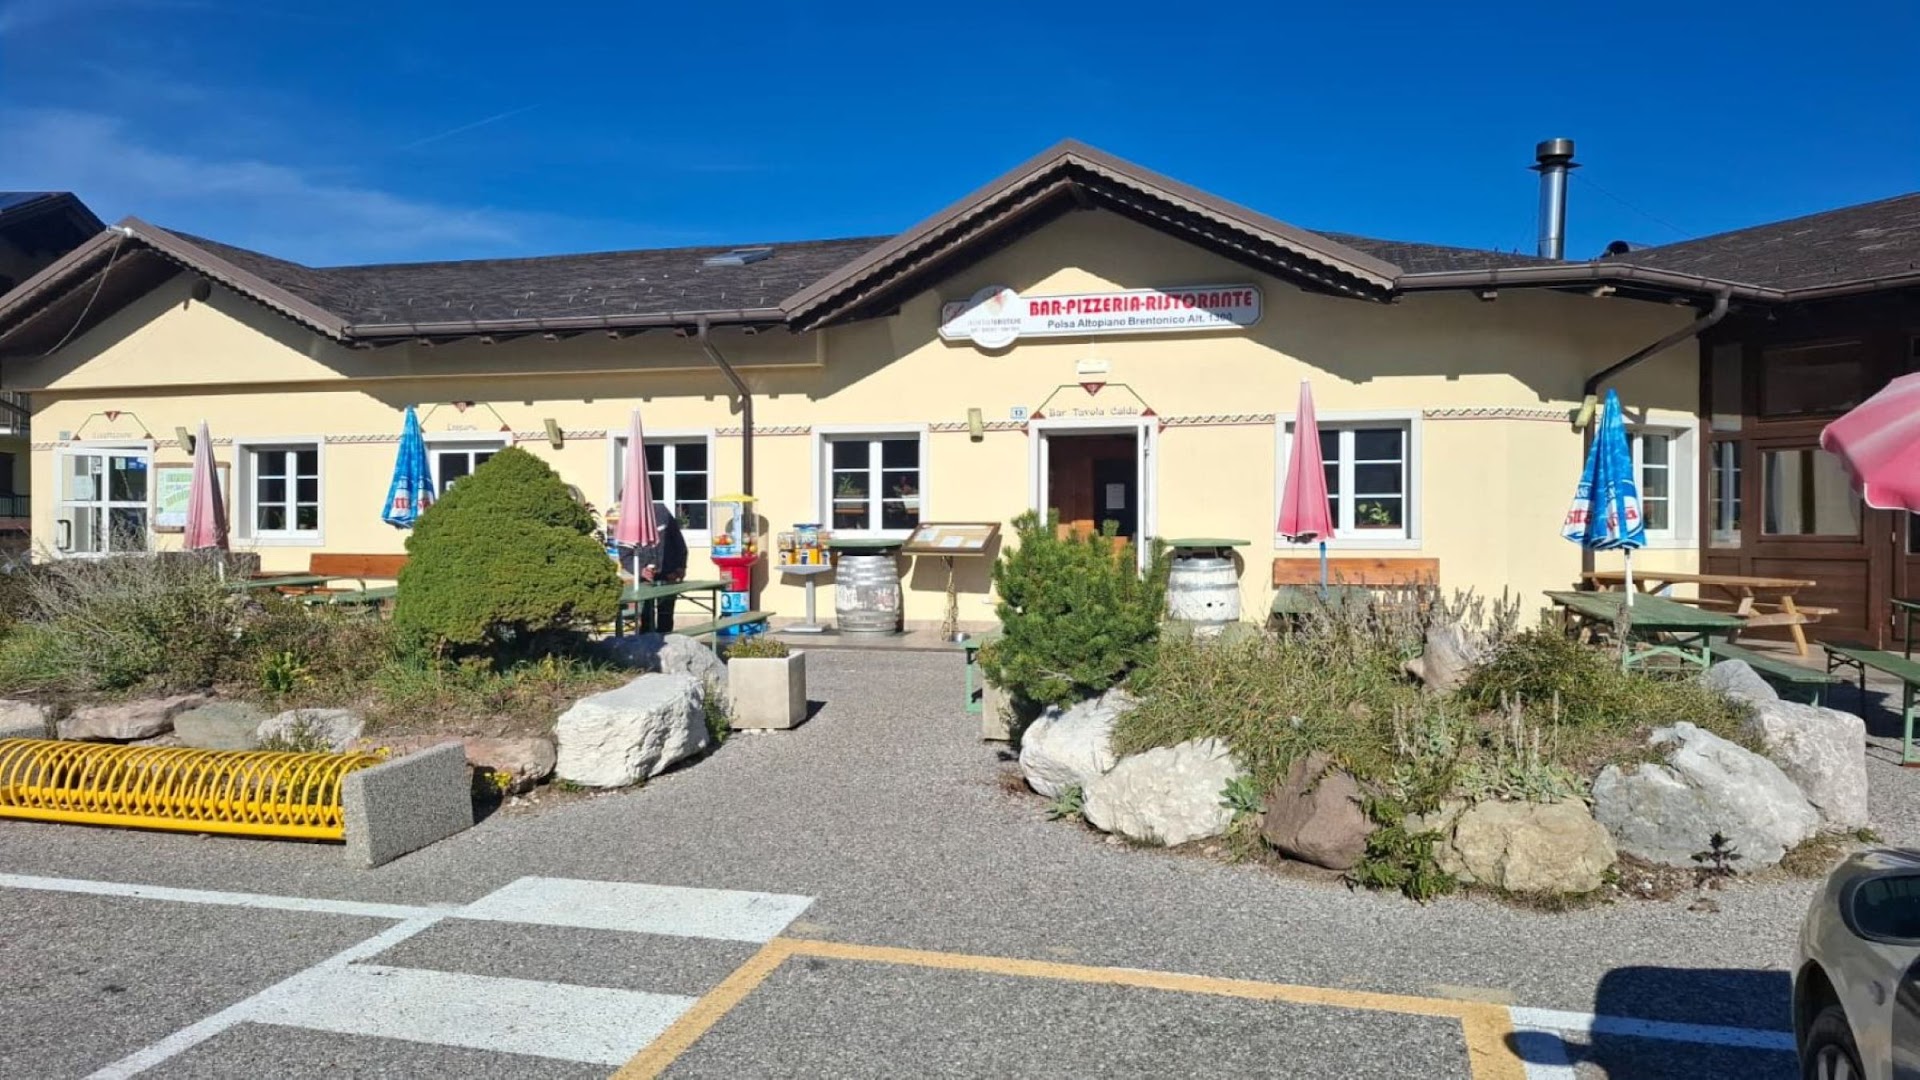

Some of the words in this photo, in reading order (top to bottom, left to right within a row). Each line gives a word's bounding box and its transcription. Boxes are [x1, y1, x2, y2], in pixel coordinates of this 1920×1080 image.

[1029, 291, 1252, 316] BAR-PIZZERIA-RISTORANTE
[1047, 319, 1075, 329] Polsa
[1077, 317, 1126, 328] Altopiano
[1127, 316, 1185, 326] Brentonico
[1188, 314, 1206, 323] Alt.
[1209, 312, 1233, 322] 1300
[1049, 408, 1067, 417] Bar
[1072, 407, 1105, 417] Tavola
